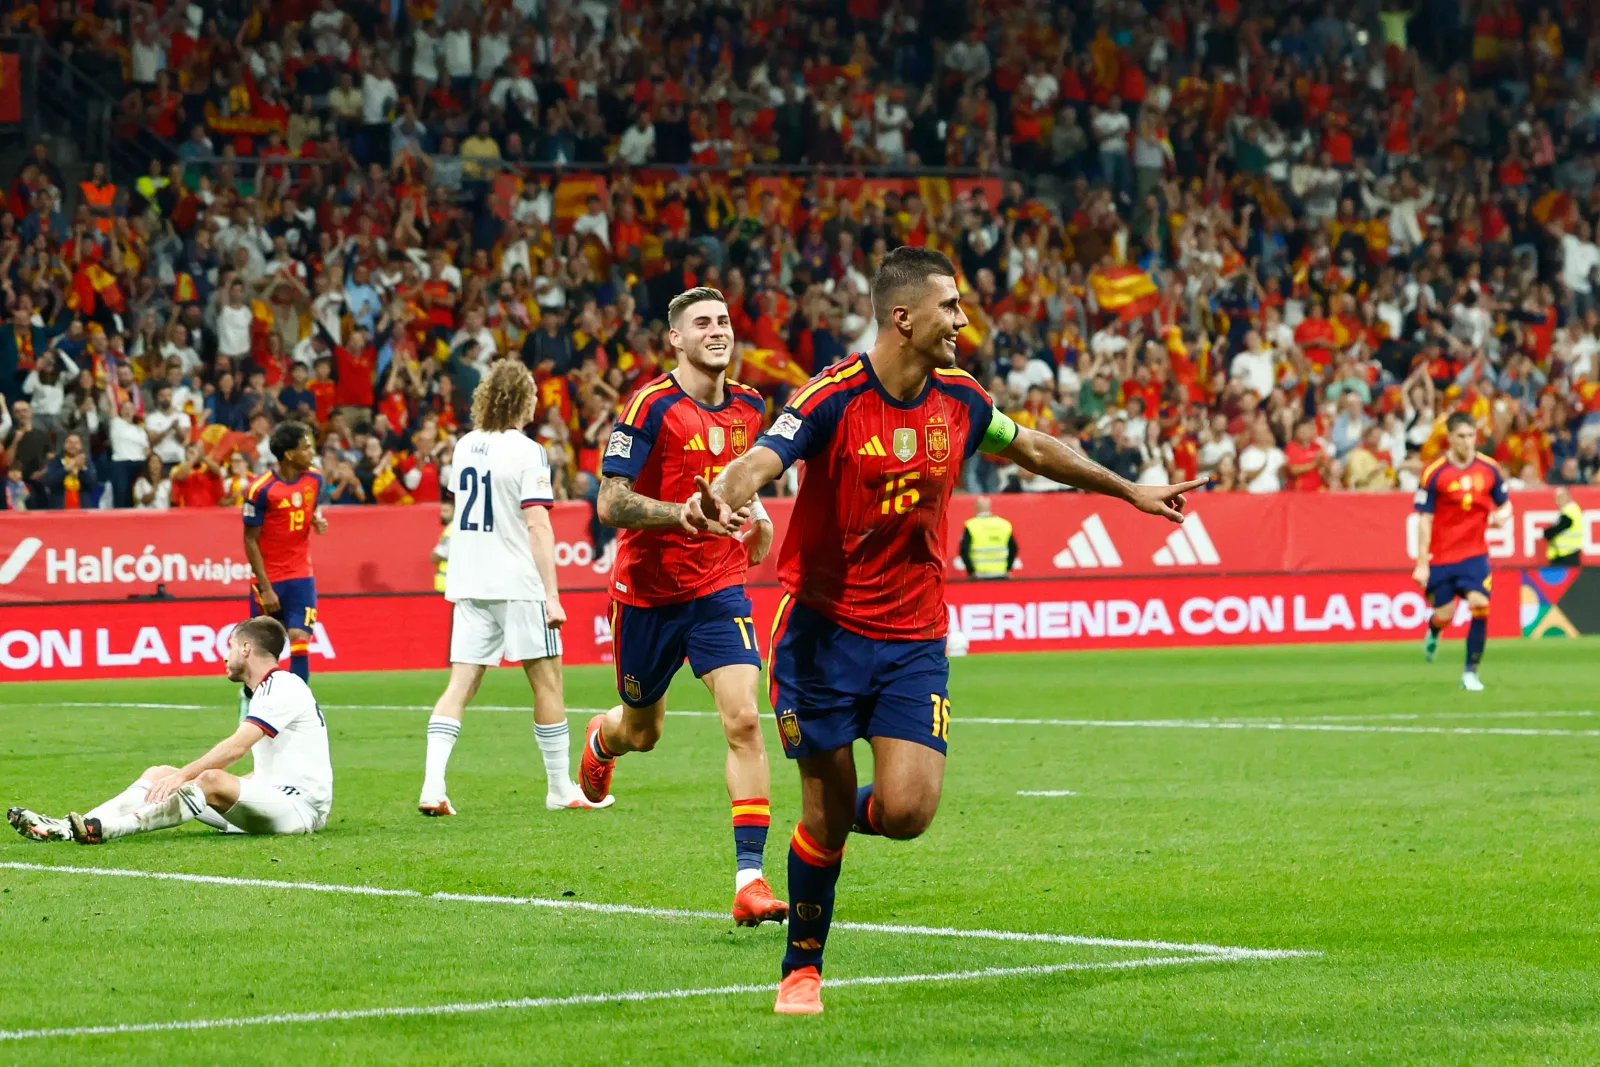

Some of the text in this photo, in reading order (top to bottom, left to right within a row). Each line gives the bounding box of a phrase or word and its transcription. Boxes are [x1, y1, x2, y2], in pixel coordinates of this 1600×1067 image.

[460, 466, 493, 532] 21
[881, 471, 920, 515] 16
[289, 510, 304, 531] 19
[46, 544, 256, 584] Halcón viajes
[1179, 595, 1284, 635] CON
[1294, 594, 1355, 631] LA
[1361, 591, 1473, 630] ROA
[96, 626, 171, 666] LA
